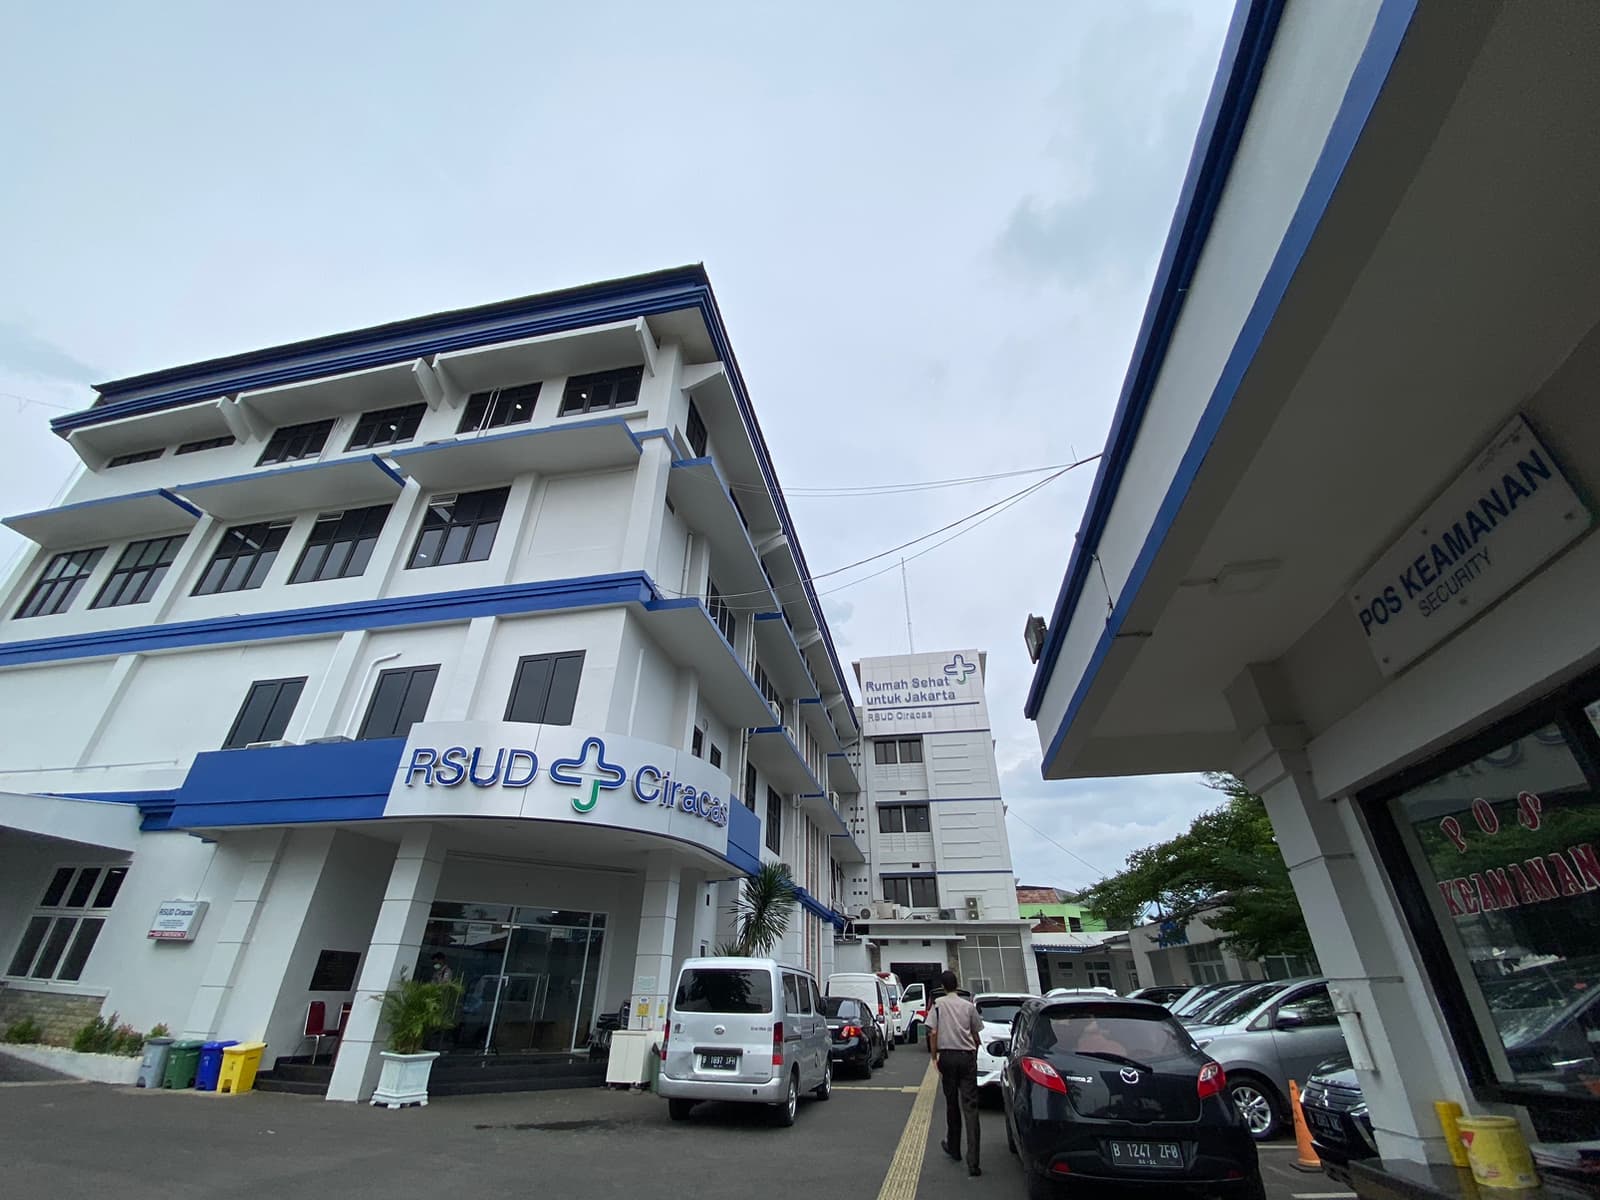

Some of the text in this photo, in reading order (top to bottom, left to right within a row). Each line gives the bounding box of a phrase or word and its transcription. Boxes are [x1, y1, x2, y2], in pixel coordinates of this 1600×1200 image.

[1358, 586, 1403, 637] POS
[1400, 450, 1552, 600] KEAMANAN
[1418, 547, 1492, 617] SECURITY
[866, 676, 950, 692] Rumah Sehat
[866, 690, 956, 705] untuk Jakarta
[868, 711, 933, 722] RSUD Ciracas
[404, 747, 729, 827] RSUD Ciracas
[1440, 791, 1542, 854] POS
[1438, 843, 1600, 917] KEAMANAN
[1112, 1143, 1121, 1157] B
[1127, 1143, 1151, 1158] 1247
